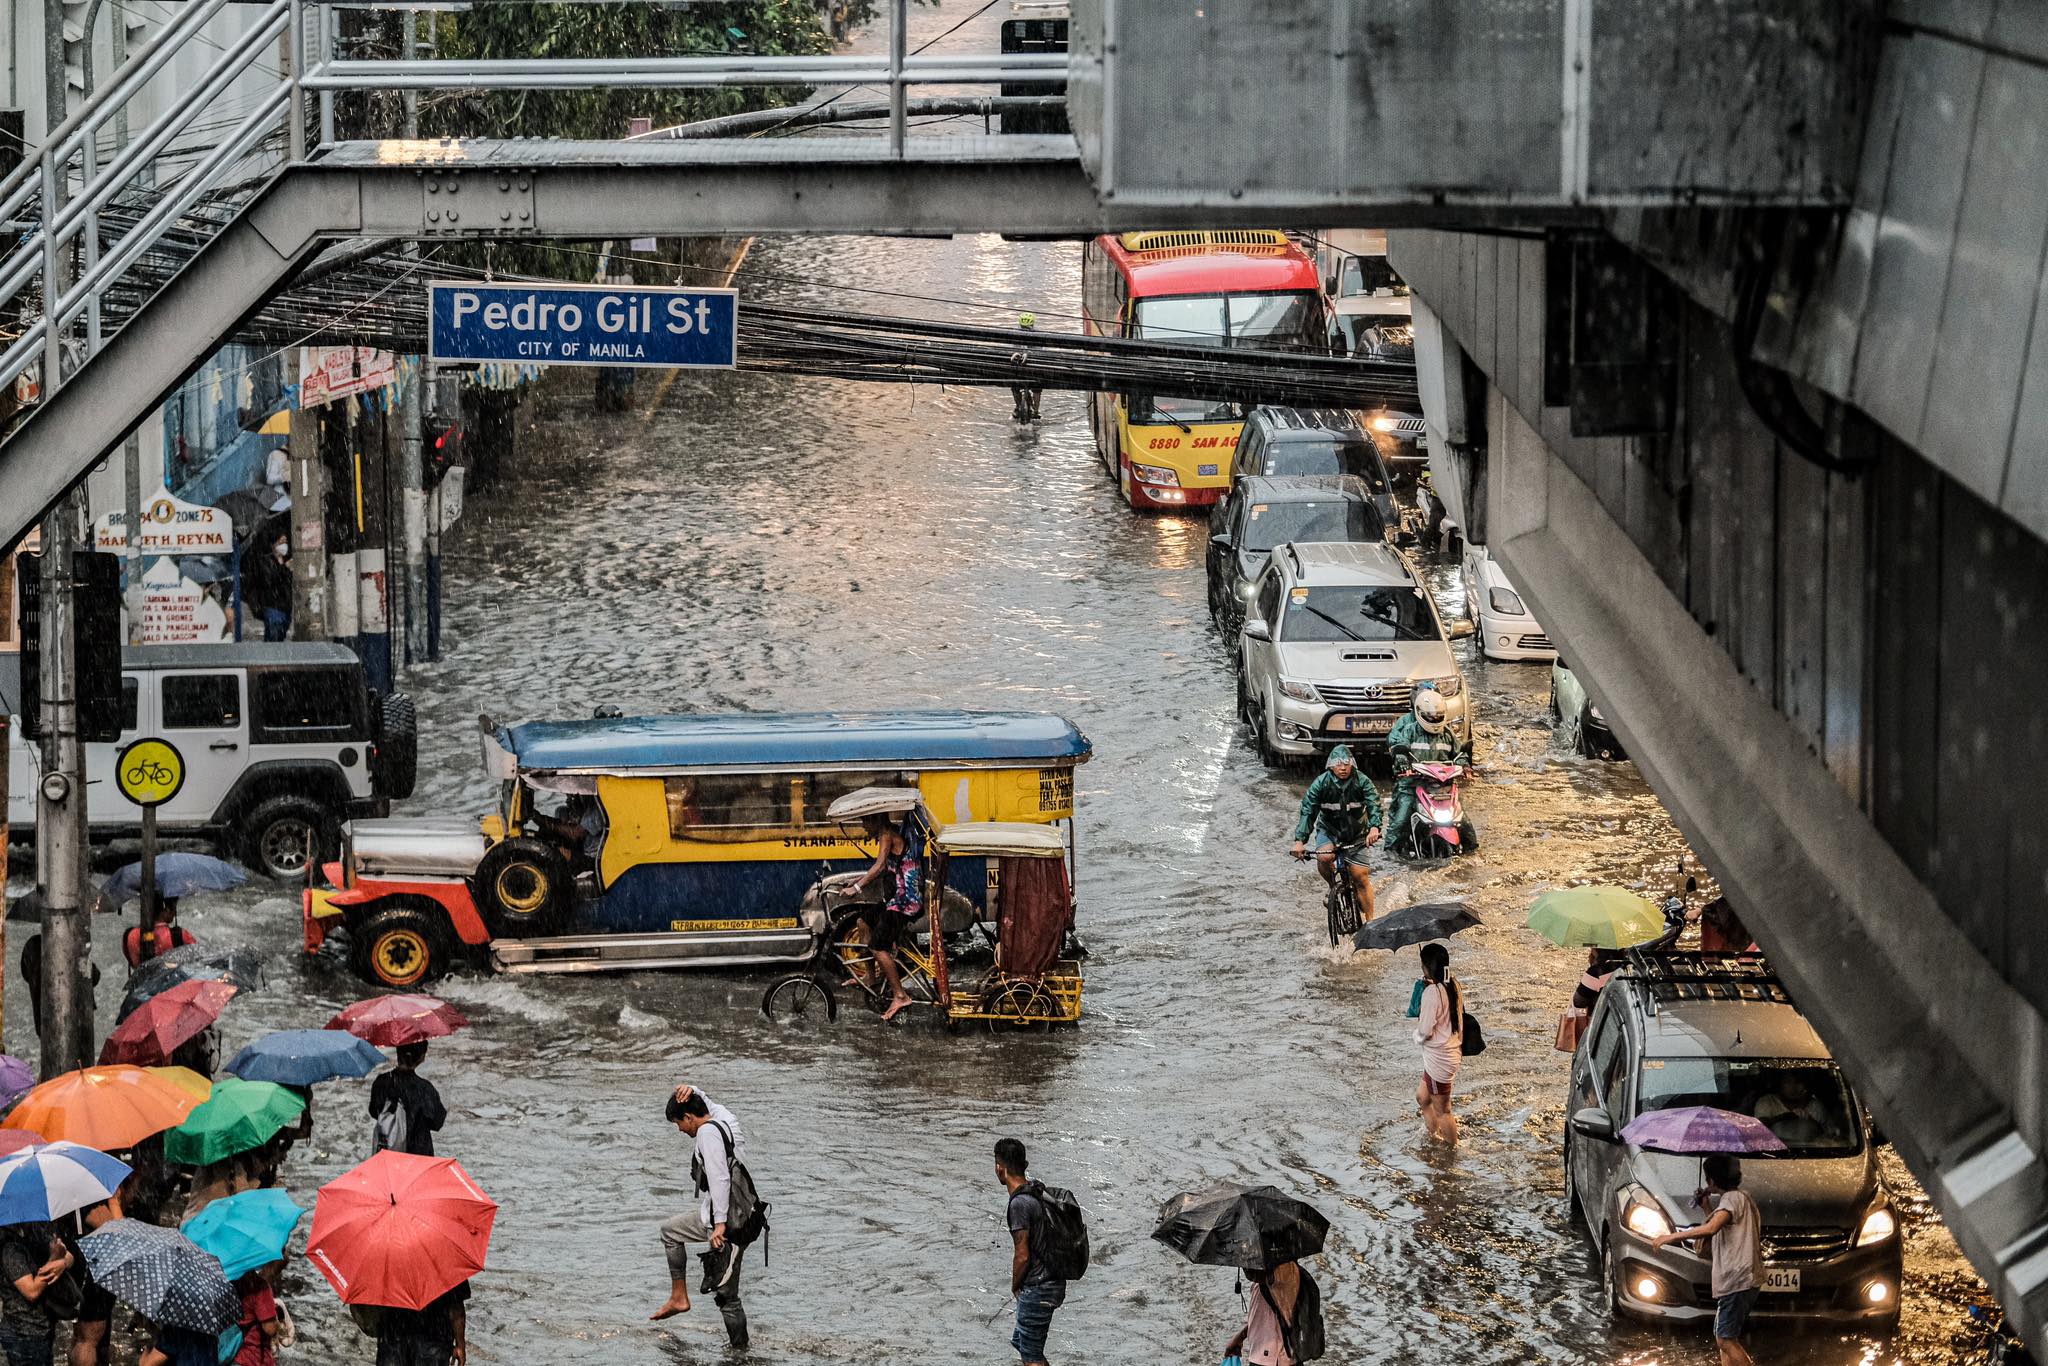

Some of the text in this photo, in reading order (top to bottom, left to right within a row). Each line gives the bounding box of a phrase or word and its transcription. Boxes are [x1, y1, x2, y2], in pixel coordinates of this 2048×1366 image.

[452, 292, 711, 335] Pedro Gil St
[518, 341, 645, 358] CITY OF MANILA
[1149, 436, 1239, 449] 8880 SAN AG
[176, 510, 200, 523] ZONE
[200, 509, 213, 523] 75
[176, 533, 224, 545] REYNA
